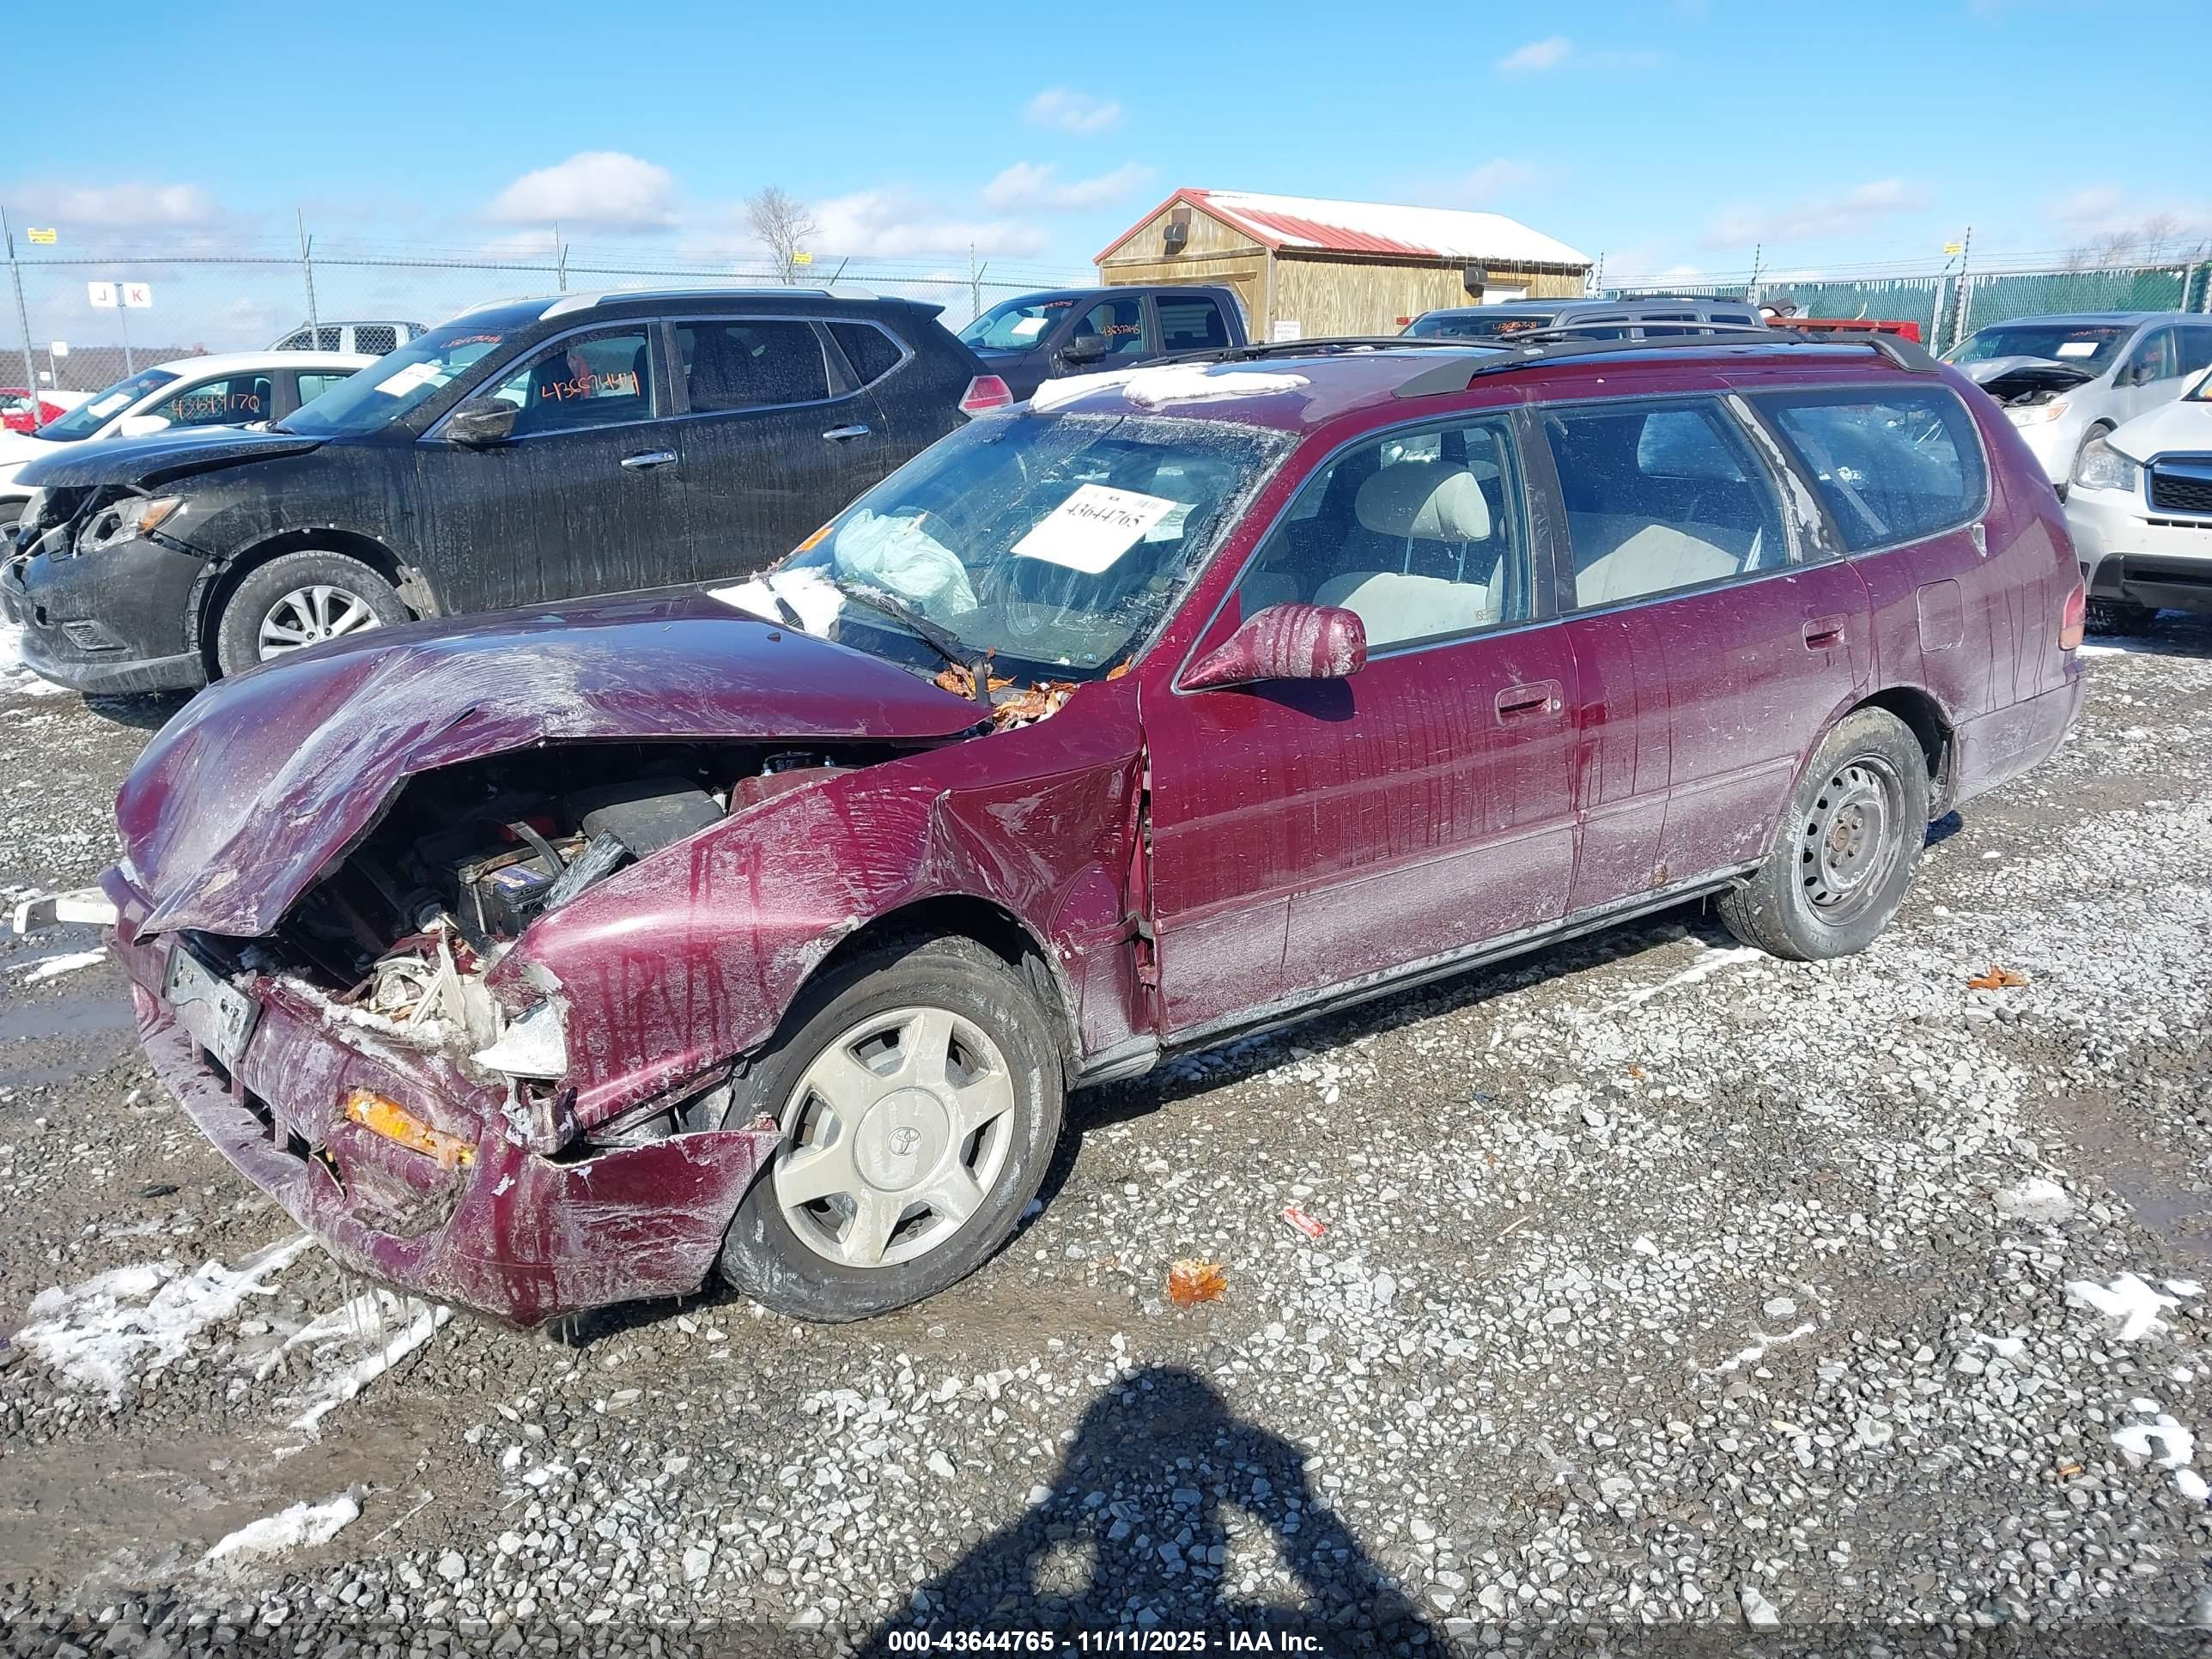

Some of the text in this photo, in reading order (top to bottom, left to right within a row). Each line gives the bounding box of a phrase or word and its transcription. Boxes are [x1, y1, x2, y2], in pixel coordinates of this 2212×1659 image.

[1586, 270, 1594, 290] 2
[98, 289, 106, 301] J
[131, 289, 143, 301] K
[1066, 502, 1146, 528] 43644765
